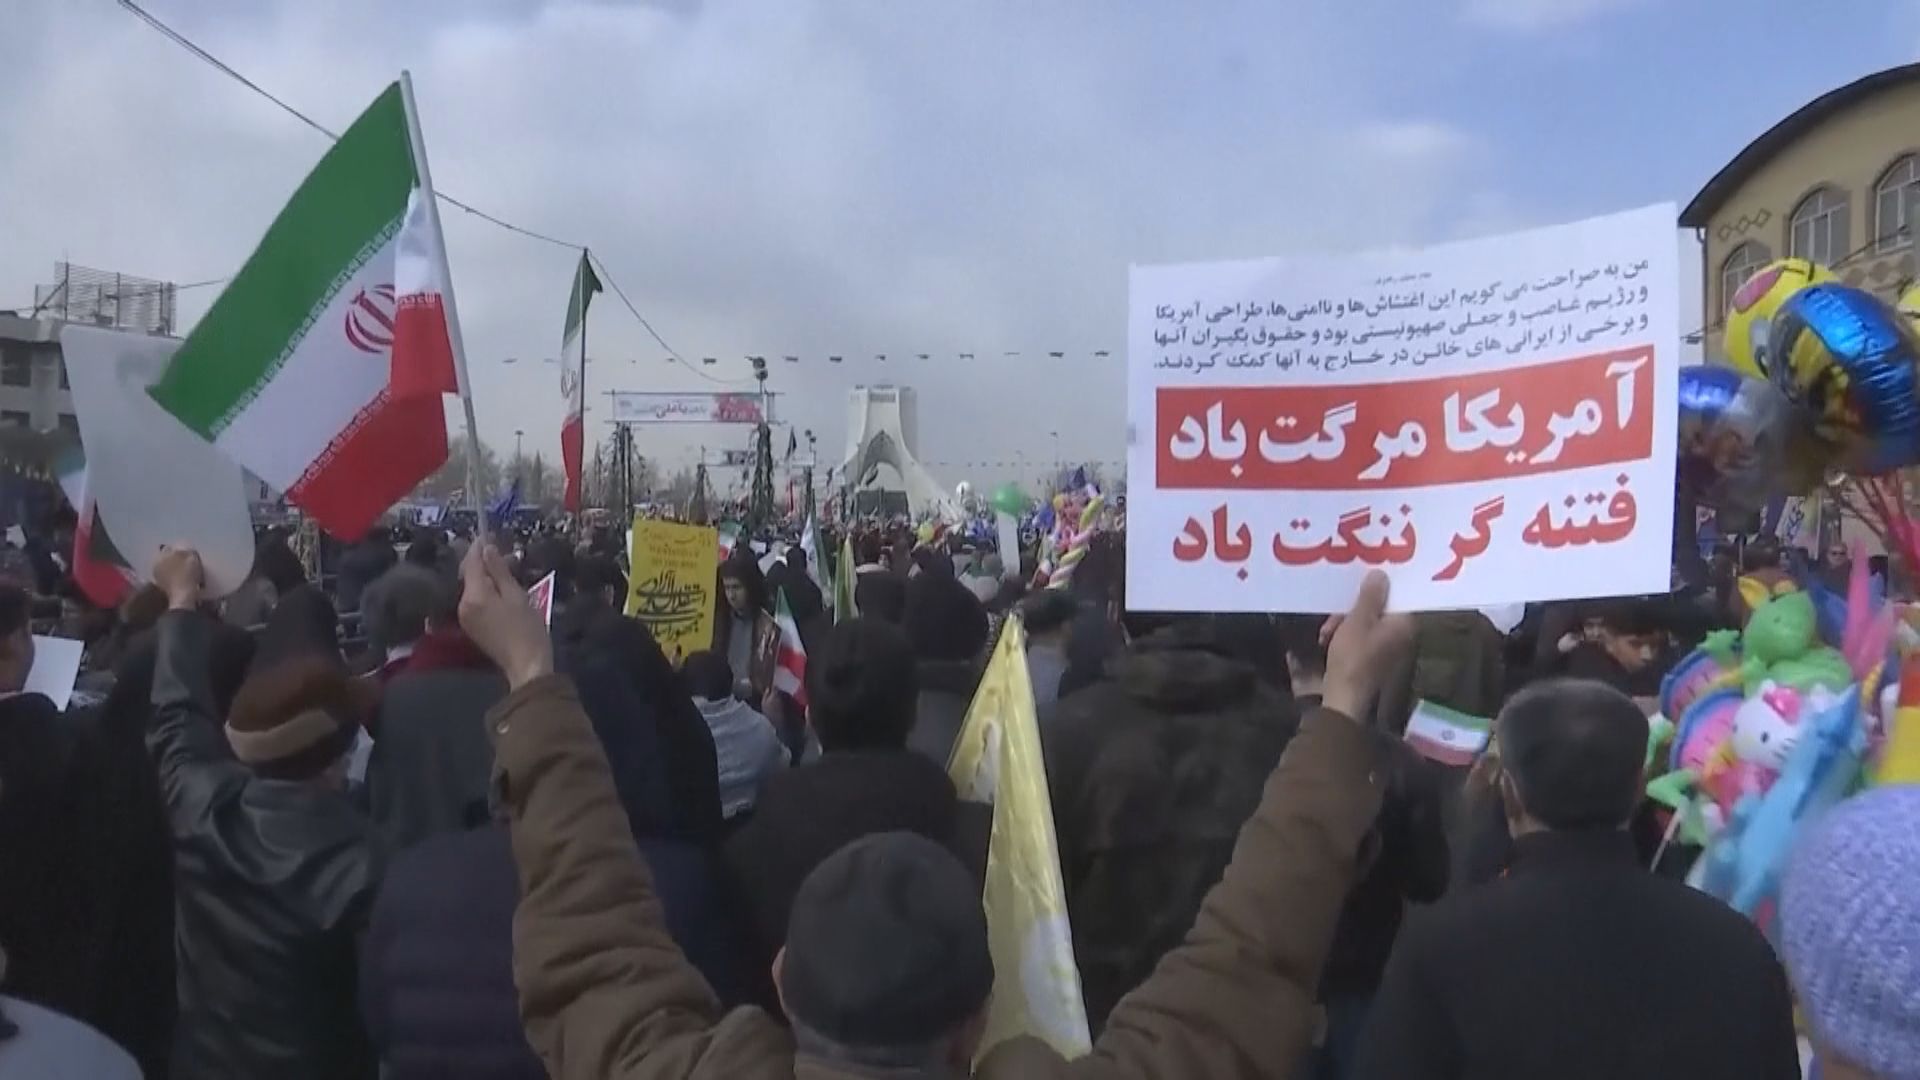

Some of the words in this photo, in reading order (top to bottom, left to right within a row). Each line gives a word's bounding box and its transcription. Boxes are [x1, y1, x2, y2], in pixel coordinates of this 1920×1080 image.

[1531, 268, 1601, 292] صراحت
[1604, 263, 1619, 280] به
[1623, 259, 1649, 279] من
[1427, 287, 1457, 312] این
[1503, 282, 1528, 302] می
[1585, 284, 1636, 313] رژیم
[1638, 285, 1649, 303] و
[1155, 300, 1201, 324] آمریکا
[1204, 301, 1264, 324] طراحی
[1336, 301, 1345, 319] و
[1507, 309, 1517, 327] و
[1520, 293, 1581, 323] غاصب
[1351, 319, 1447, 345] صهیونیستی
[1449, 310, 1504, 336] جعلی
[1576, 315, 1635, 344] برخی
[1638, 312, 1649, 331] و
[1153, 325, 1187, 348] آنها
[1191, 326, 1249, 349] بگیران
[1252, 326, 1307, 347] حقوق
[1311, 328, 1320, 346] و
[1323, 327, 1349, 346] بود
[1505, 326, 1554, 355] ایرانی
[1557, 322, 1573, 345] از
[1389, 346, 1409, 366] در
[1412, 338, 1461, 366] خائن
[1465, 335, 1501, 358] های
[1225, 351, 1271, 369] کمک
[1275, 348, 1301, 371] آنها
[1306, 353, 1320, 370] به
[1323, 347, 1385, 372] خارج
[1443, 356, 1650, 467] آمریکا
[1169, 400, 1248, 479] باد
[1257, 400, 1428, 483] مرگت
[1521, 471, 1639, 549] فتنه
[1171, 503, 1253, 582] باد
[1271, 503, 1418, 567] ننگت
[1430, 495, 1506, 582] گر
